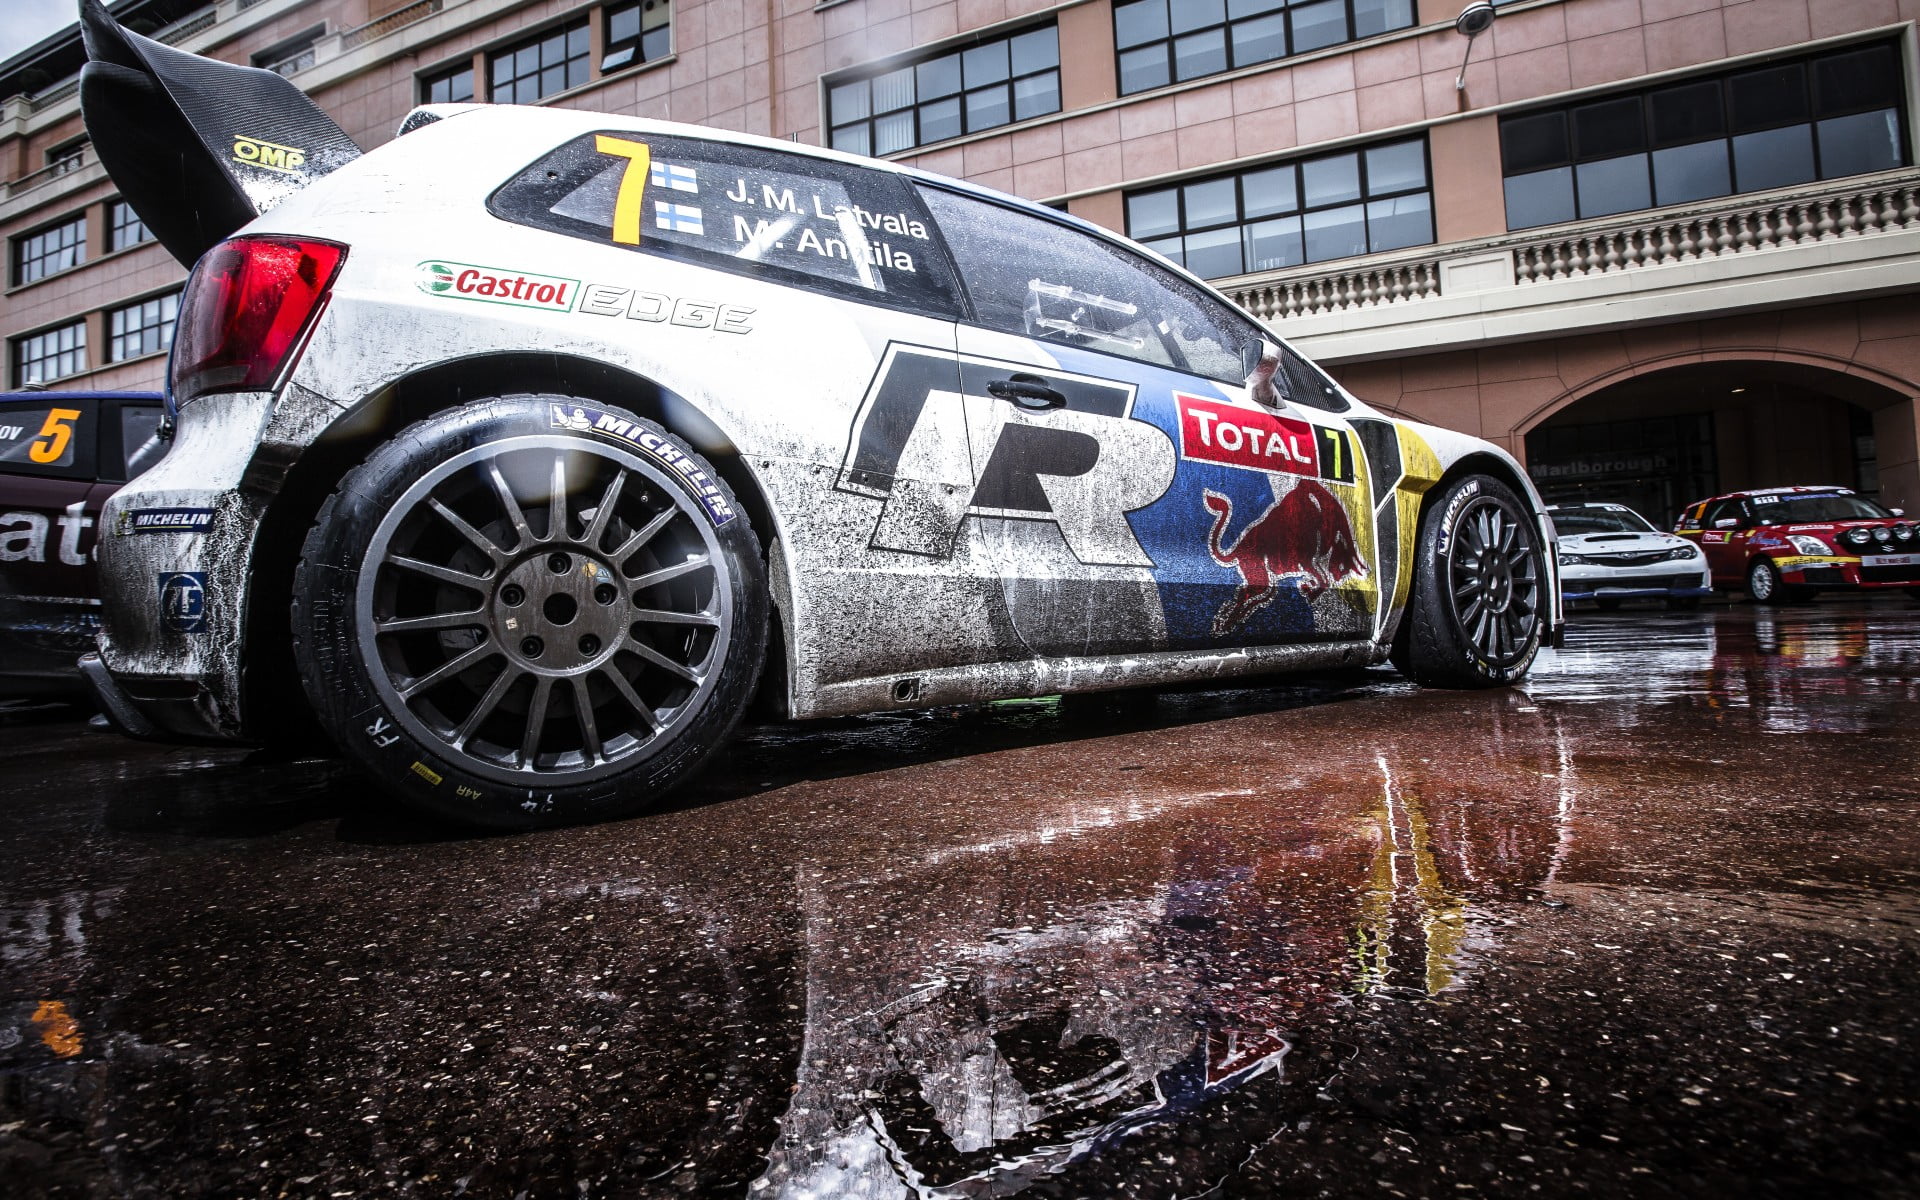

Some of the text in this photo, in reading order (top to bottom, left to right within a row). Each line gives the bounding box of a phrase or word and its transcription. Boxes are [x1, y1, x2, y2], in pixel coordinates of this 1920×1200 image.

[233, 141, 305, 169] OMP
[594, 134, 651, 246] 7
[726, 178, 755, 205] J.
[762, 184, 805, 215] M.
[456, 268, 758, 336] Castrol EDGE
[0, 423, 24, 441] OV
[29, 407, 83, 464] 5
[1187, 408, 1312, 465] TOTAL
[594, 413, 734, 518] MICHELIN
[0, 500, 97, 566] at
[135, 512, 214, 526] MICHELIN
[365, 716, 401, 748] FR
